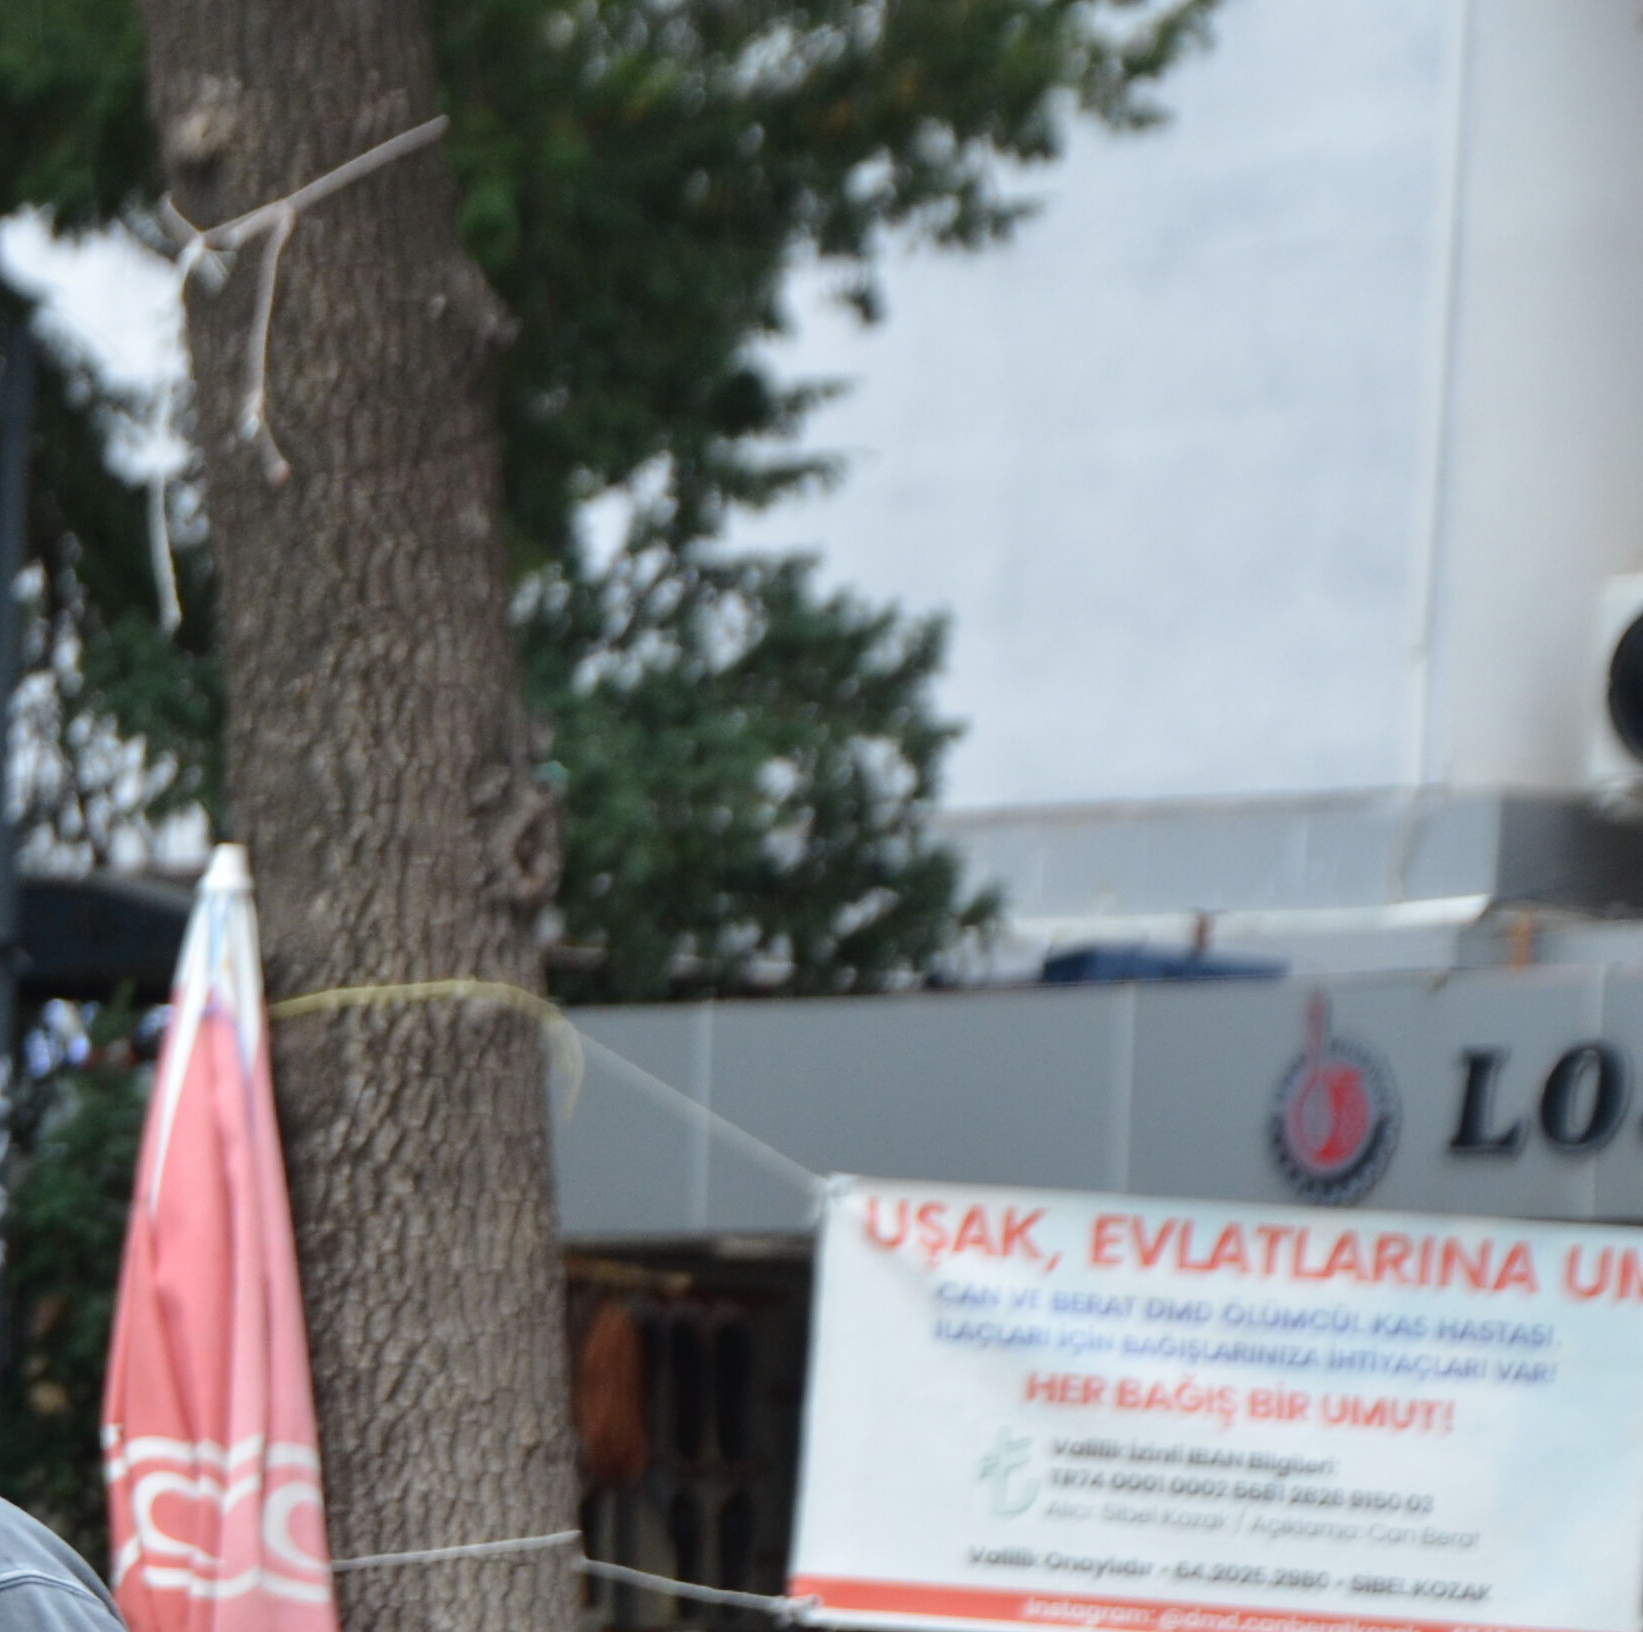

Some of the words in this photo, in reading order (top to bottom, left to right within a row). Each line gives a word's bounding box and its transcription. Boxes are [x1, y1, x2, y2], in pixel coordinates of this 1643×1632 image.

[1449, 1038, 1643, 1156] LO
[866, 1196, 1062, 1272] UŞAK,
[1090, 1212, 1540, 1294] EVLATLARINA
[1372, 1311, 1428, 1338] KAS
[1025, 1370, 1107, 1406] HER
[1115, 1372, 1237, 1430] BAĞIŞ
[1248, 1381, 1311, 1422] BİR
[1321, 1394, 1457, 1434] UMUT!
